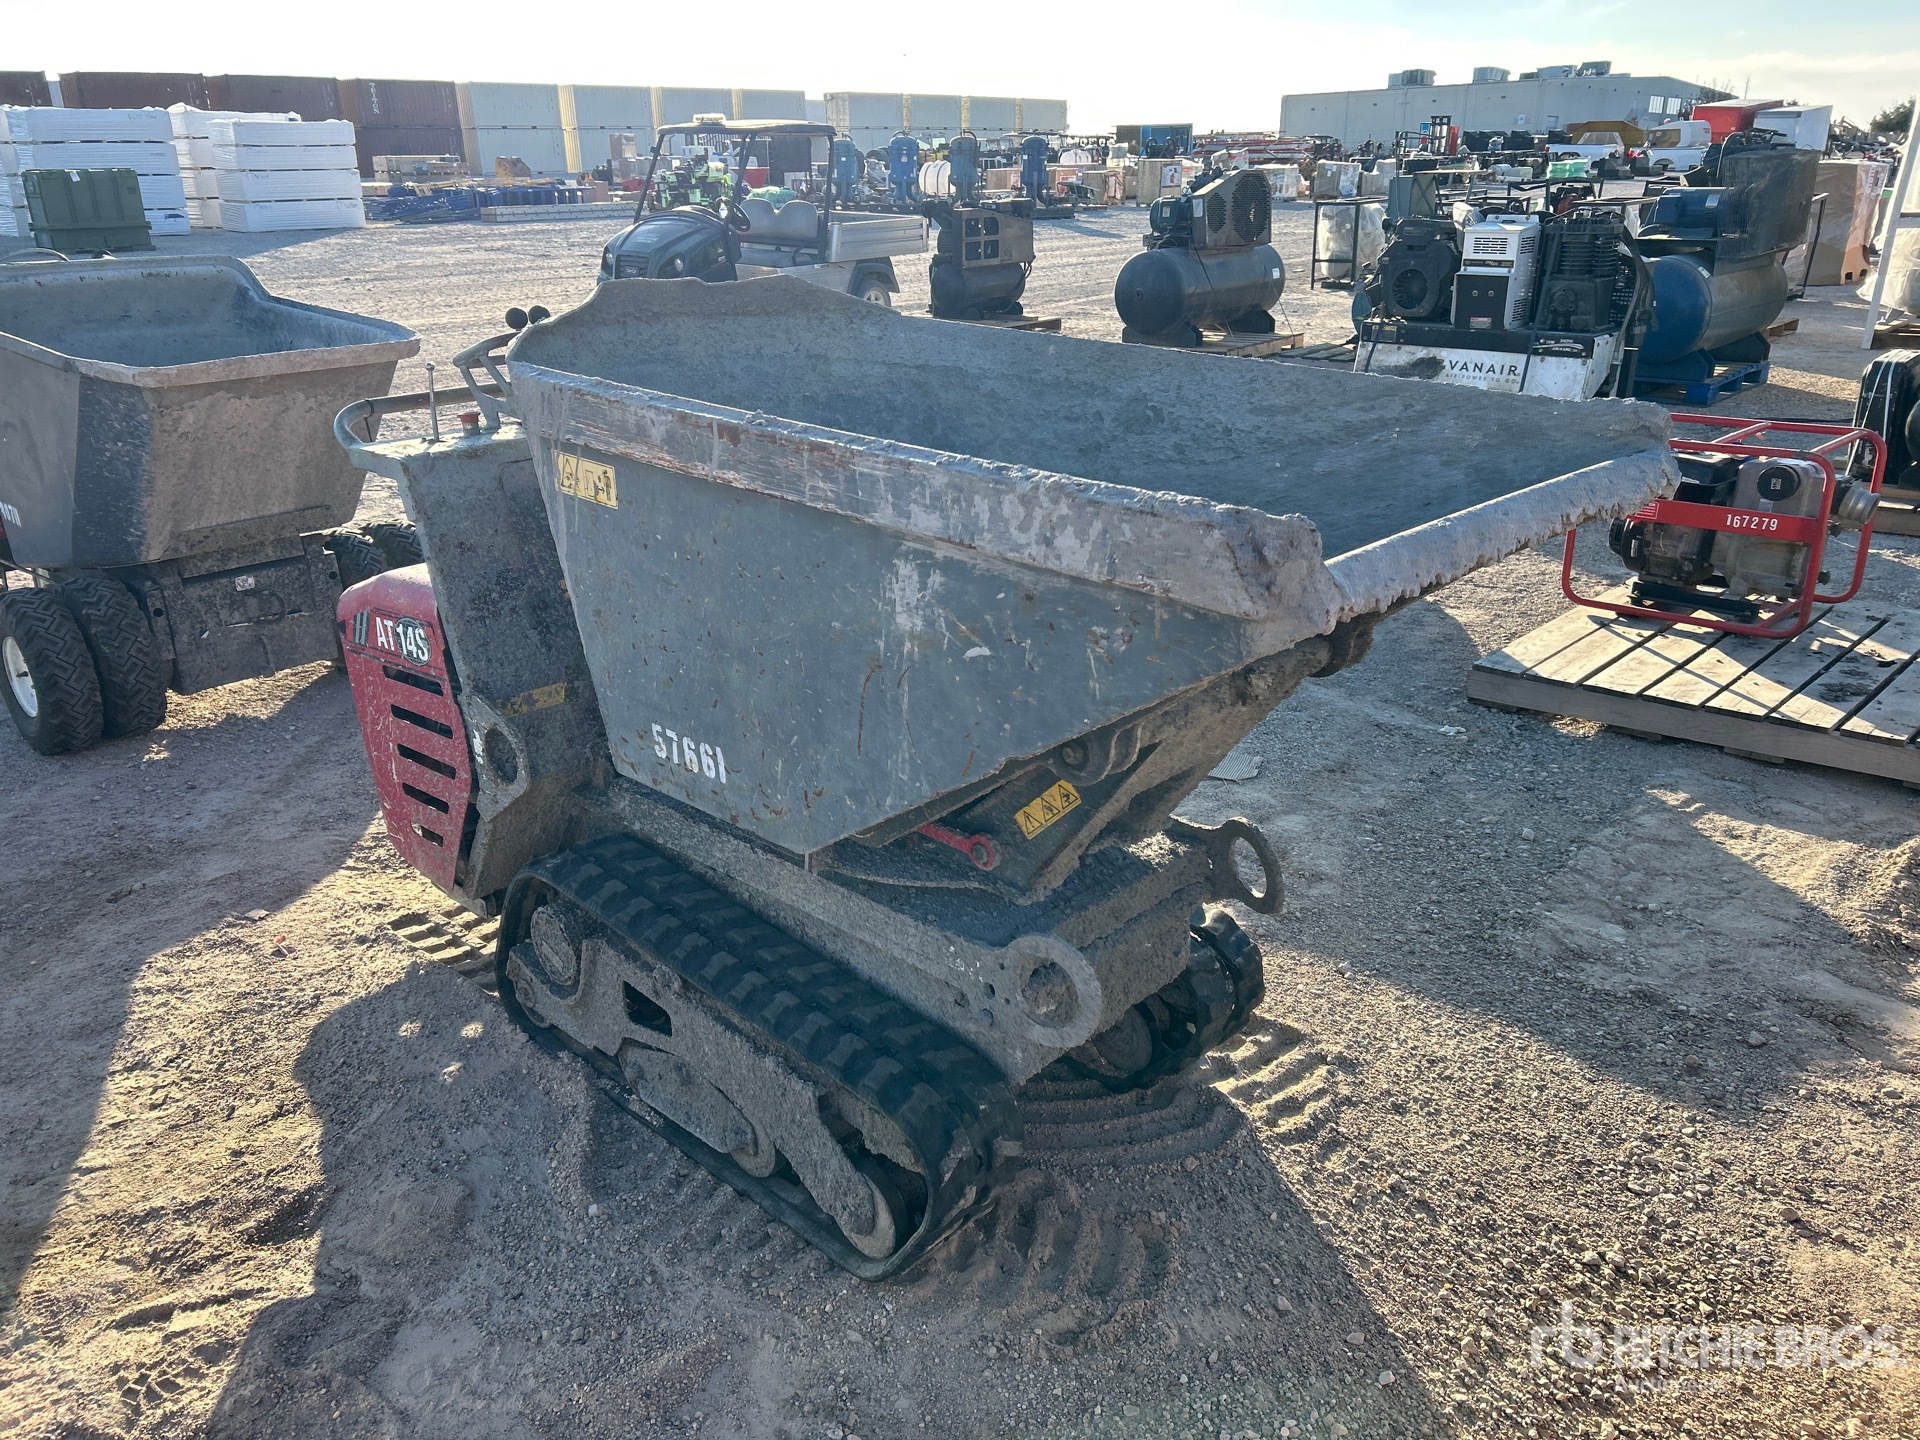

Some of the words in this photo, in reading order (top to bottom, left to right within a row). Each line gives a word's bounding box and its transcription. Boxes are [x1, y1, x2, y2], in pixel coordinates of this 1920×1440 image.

[369, 82, 380, 114] TRITON
[1449, 360, 1518, 377] VANAIR
[1461, 374, 1487, 382] POWER
[1726, 513, 1778, 531] 167279
[651, 722, 727, 784] 57661
